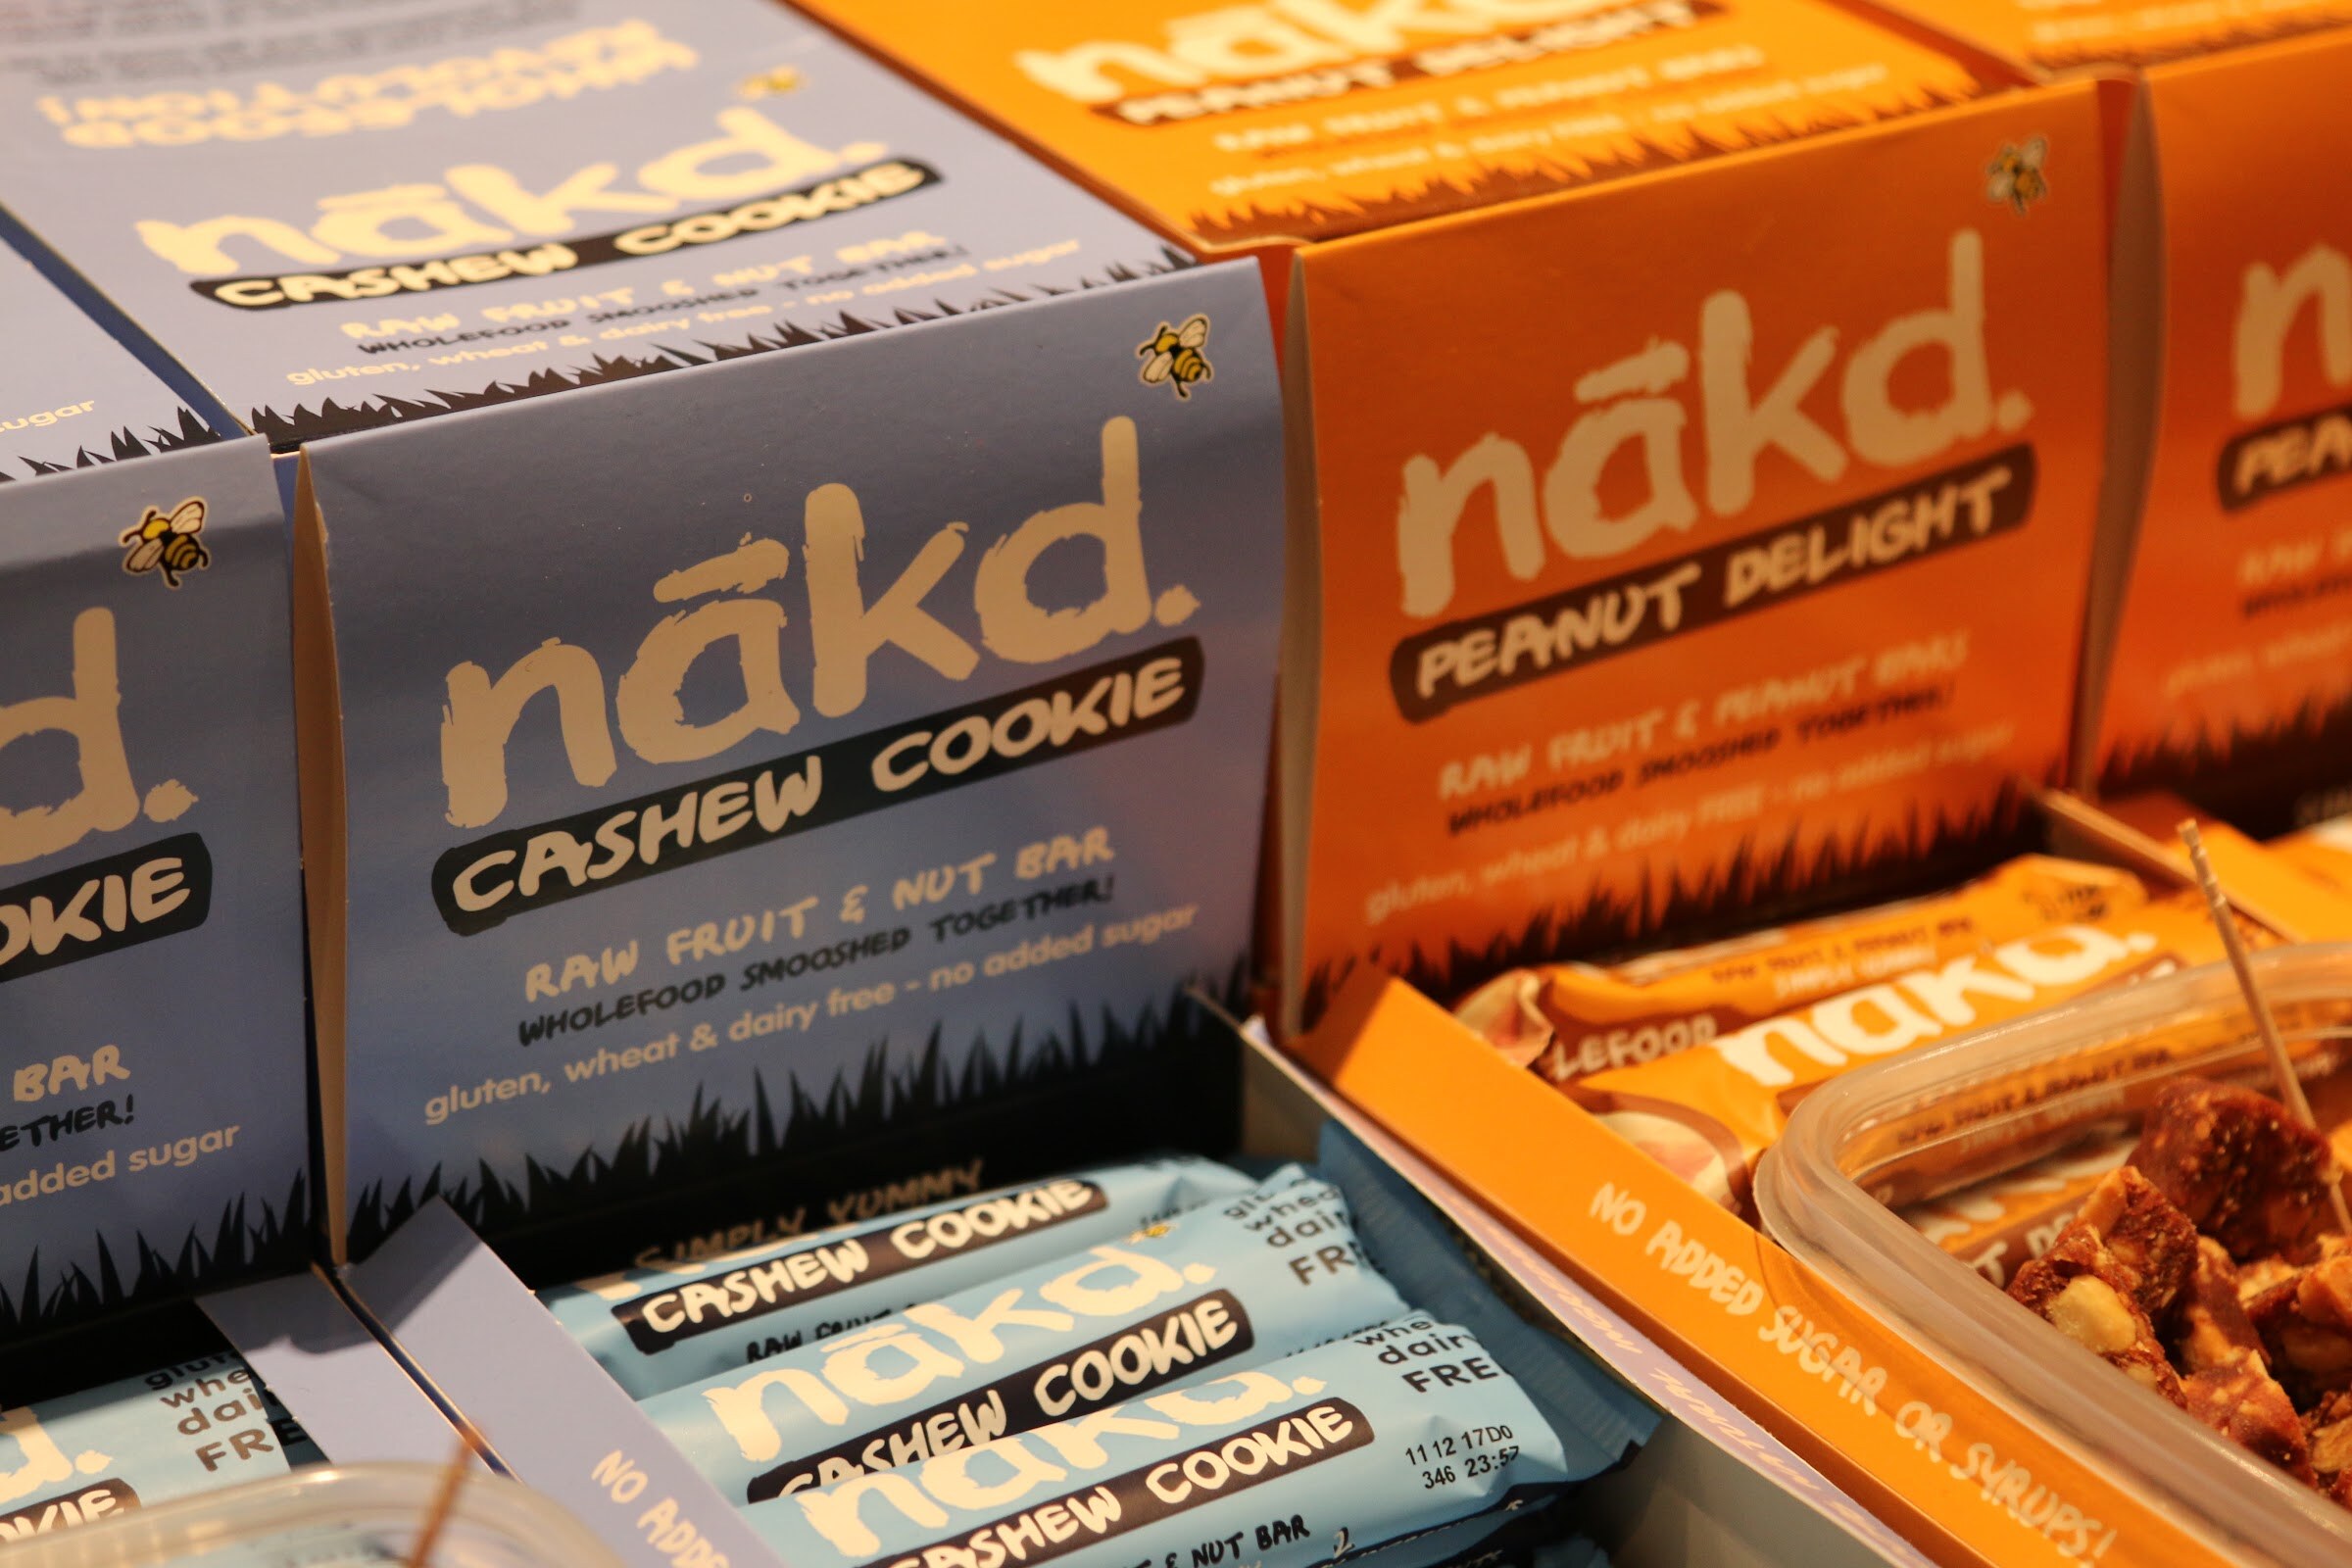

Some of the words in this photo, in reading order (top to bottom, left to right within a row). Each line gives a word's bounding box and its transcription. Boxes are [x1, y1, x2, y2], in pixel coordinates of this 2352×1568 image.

[216, 243, 578, 308] CASHEW
[614, 161, 926, 256] COOKIE
[286, 358, 420, 385] gluten,
[428, 341, 549, 367] wheat
[600, 318, 690, 341] dairy
[341, 312, 461, 340] RAW
[483, 287, 635, 322] FRUIT
[357, 318, 571, 355] WHOLEFOOD
[1417, 563, 1702, 699] PEANUT
[1724, 466, 2013, 608] DELIGHT
[452, 756, 822, 912] CASHEW
[871, 658, 1187, 792] COOKIE
[525, 941, 639, 1003] RAW
[667, 898, 820, 967] FRUIT
[840, 884, 868, 923] &
[893, 852, 996, 909] NUT
[1015, 826, 1115, 881] BAR
[518, 972, 726, 1049] WHOLEFOOD
[740, 925, 909, 993] SMOOSHED
[929, 875, 1115, 940] TOGETHER!
[424, 1066, 552, 1126] gluten,
[564, 1029, 681, 1084] wheat
[690, 1020, 718, 1052] &
[727, 997, 818, 1044] dairy
[826, 978, 896, 1017] free
[929, 961, 977, 994] no
[983, 931, 1096, 980] added
[1102, 905, 1200, 951] sugar
[13, 1045, 131, 1102] BAR
[128, 1124, 241, 1172] sugar
[827, 1157, 983, 1224] YUMMY
[642, 1239, 870, 1333] CASHEW
[890, 1179, 1094, 1258] COOKIE
[1034, 1299, 1239, 1417] COOKIE
[1589, 1182, 1646, 1236] NO
[1645, 1219, 1764, 1316] ADDED
[1759, 1304, 1893, 1417] SUGAR
[1894, 1400, 1954, 1464] OR
[1950, 1443, 2117, 1568] SYRUPS!
[591, 1448, 649, 1504] NO
[1146, 1405, 1354, 1504] COOKIE
[1405, 1444, 1428, 1466] 11
[1433, 1437, 1457, 1459] 12
[1422, 1465, 1456, 1490] 346
[1464, 1446, 1520, 1478] 23:57
[1191, 1531, 1245, 1568] NUT
[1254, 1513, 1311, 1551] BAR
